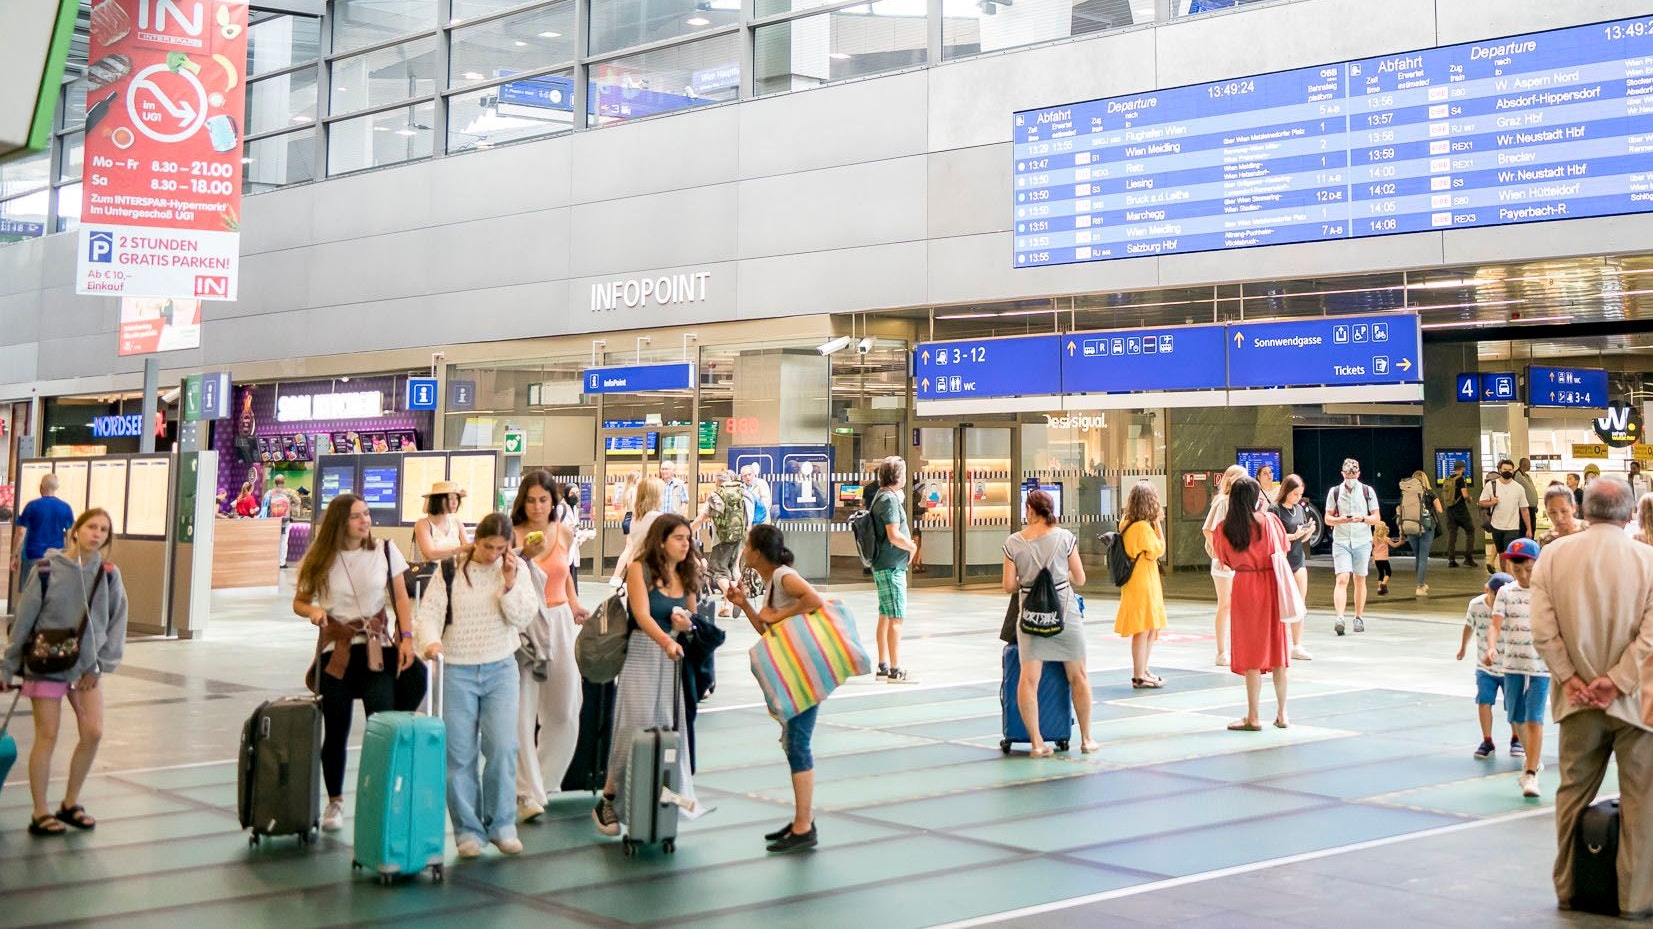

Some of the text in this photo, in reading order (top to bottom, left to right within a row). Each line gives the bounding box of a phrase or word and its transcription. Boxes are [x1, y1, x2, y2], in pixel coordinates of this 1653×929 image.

[138, 0, 204, 36] IN
[1378, 55, 1424, 73] Abfahrt
[1470, 40, 1537, 61] Departure
[1513, 76, 1551, 90] Aspern
[1553, 70, 1580, 83] Nord
[1036, 80, 1254, 125] Abfahrt Departure 13:49:24
[1367, 86, 1601, 126] 13:57 S4 Absdorf-Hippersdorf
[142, 111, 162, 122] UG1
[1496, 116, 1522, 127] Graz
[1524, 112, 1544, 124] Hbf
[1028, 158, 1049, 170] 13:47
[1125, 147, 1147, 157] Wien
[1148, 142, 1181, 154] Meidling
[1320, 122, 1326, 132] 1
[1320, 139, 1327, 149] 2
[1368, 148, 1395, 161] 13:59
[1451, 141, 1473, 151] REX1
[1566, 125, 1586, 138] Hbf
[92, 156, 233, 178] Mo Fr 8.30 21.00
[1369, 166, 1395, 178] 14:00
[1452, 159, 1473, 169] REX1
[91, 174, 233, 195] Sa 8.30 18.00
[1028, 190, 1050, 202] 13:50
[1126, 178, 1154, 190] Liesing
[1321, 156, 1326, 166] 1
[1369, 183, 1396, 196] 14:02
[1452, 179, 1464, 188] S3
[1567, 162, 1587, 176] Hbf
[90, 193, 113, 204] Zum
[1498, 189, 1526, 201] Wien
[175, 210, 195, 221] UG1
[1028, 221, 1048, 233] 13:51
[1126, 210, 1166, 221] Marchegg
[1316, 190, 1328, 201] 12
[1370, 202, 1570, 231] 14:08 REX3 Payerbach-R.
[119, 236, 198, 251] 2 STUNDEN
[1028, 251, 1049, 263] 13:55
[1127, 241, 1161, 254] Salzburg
[1162, 239, 1178, 250] Hbf
[1321, 225, 1329, 236] 7
[119, 252, 230, 270] GRATIS PARKEN!
[88, 270, 102, 279] Ab
[87, 281, 125, 291] Einkauf
[196, 277, 226, 294] IN
[591, 271, 711, 311] INFOPOINT
[1254, 335, 1322, 349] Sonnwendgasse
[1333, 365, 1366, 377] Tickets
[1573, 376, 1582, 384] WC
[603, 379, 627, 388] InfoPoint
[963, 381, 977, 391] WC
[1461, 378, 1474, 397] 4
